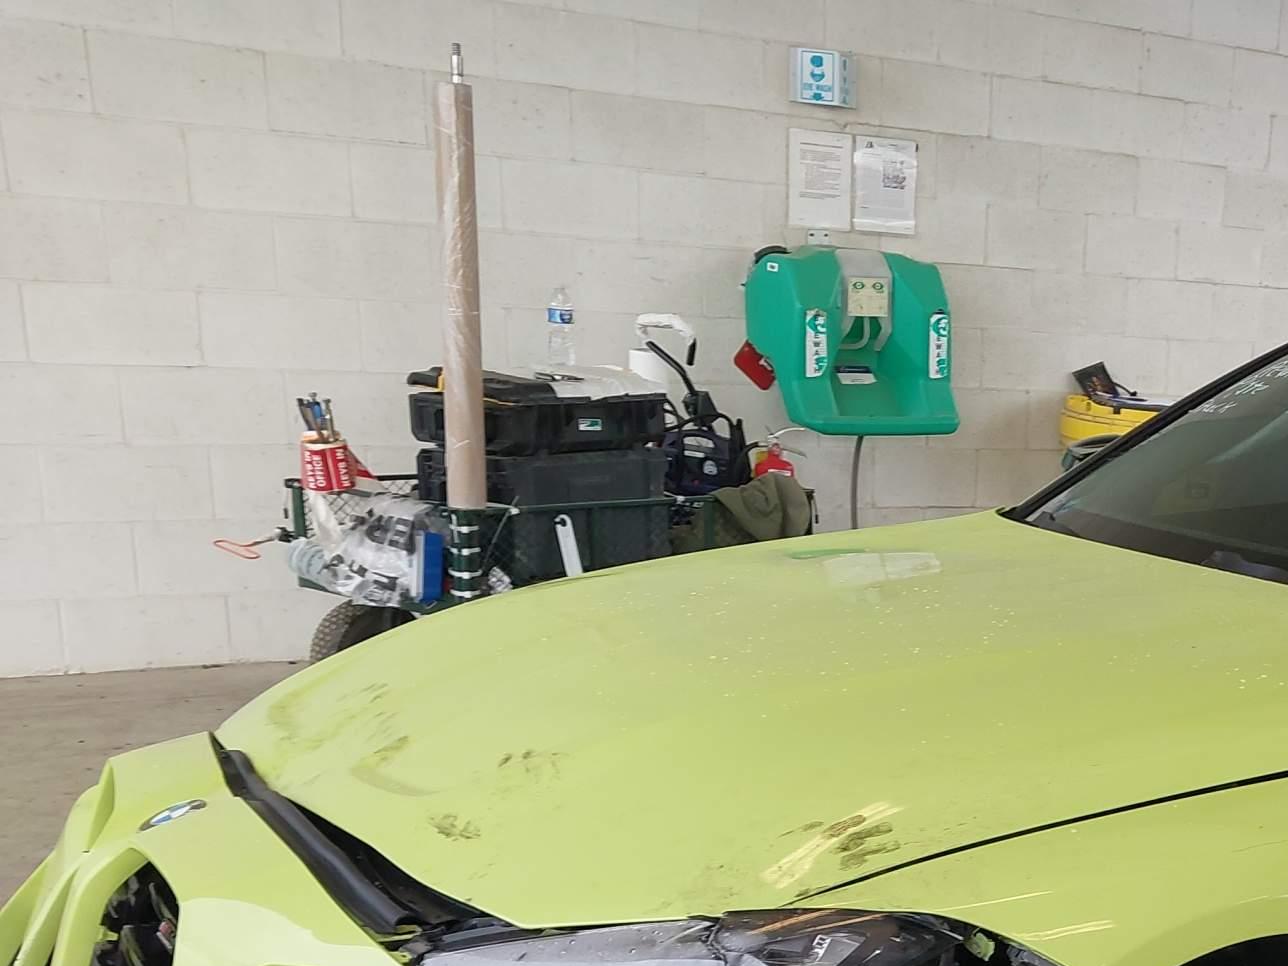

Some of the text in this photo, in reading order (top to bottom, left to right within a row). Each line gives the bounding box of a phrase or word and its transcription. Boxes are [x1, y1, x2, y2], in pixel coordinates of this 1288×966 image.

[311, 454, 327, 488] OFFICE
[335, 449, 351, 487] KEYS IN
